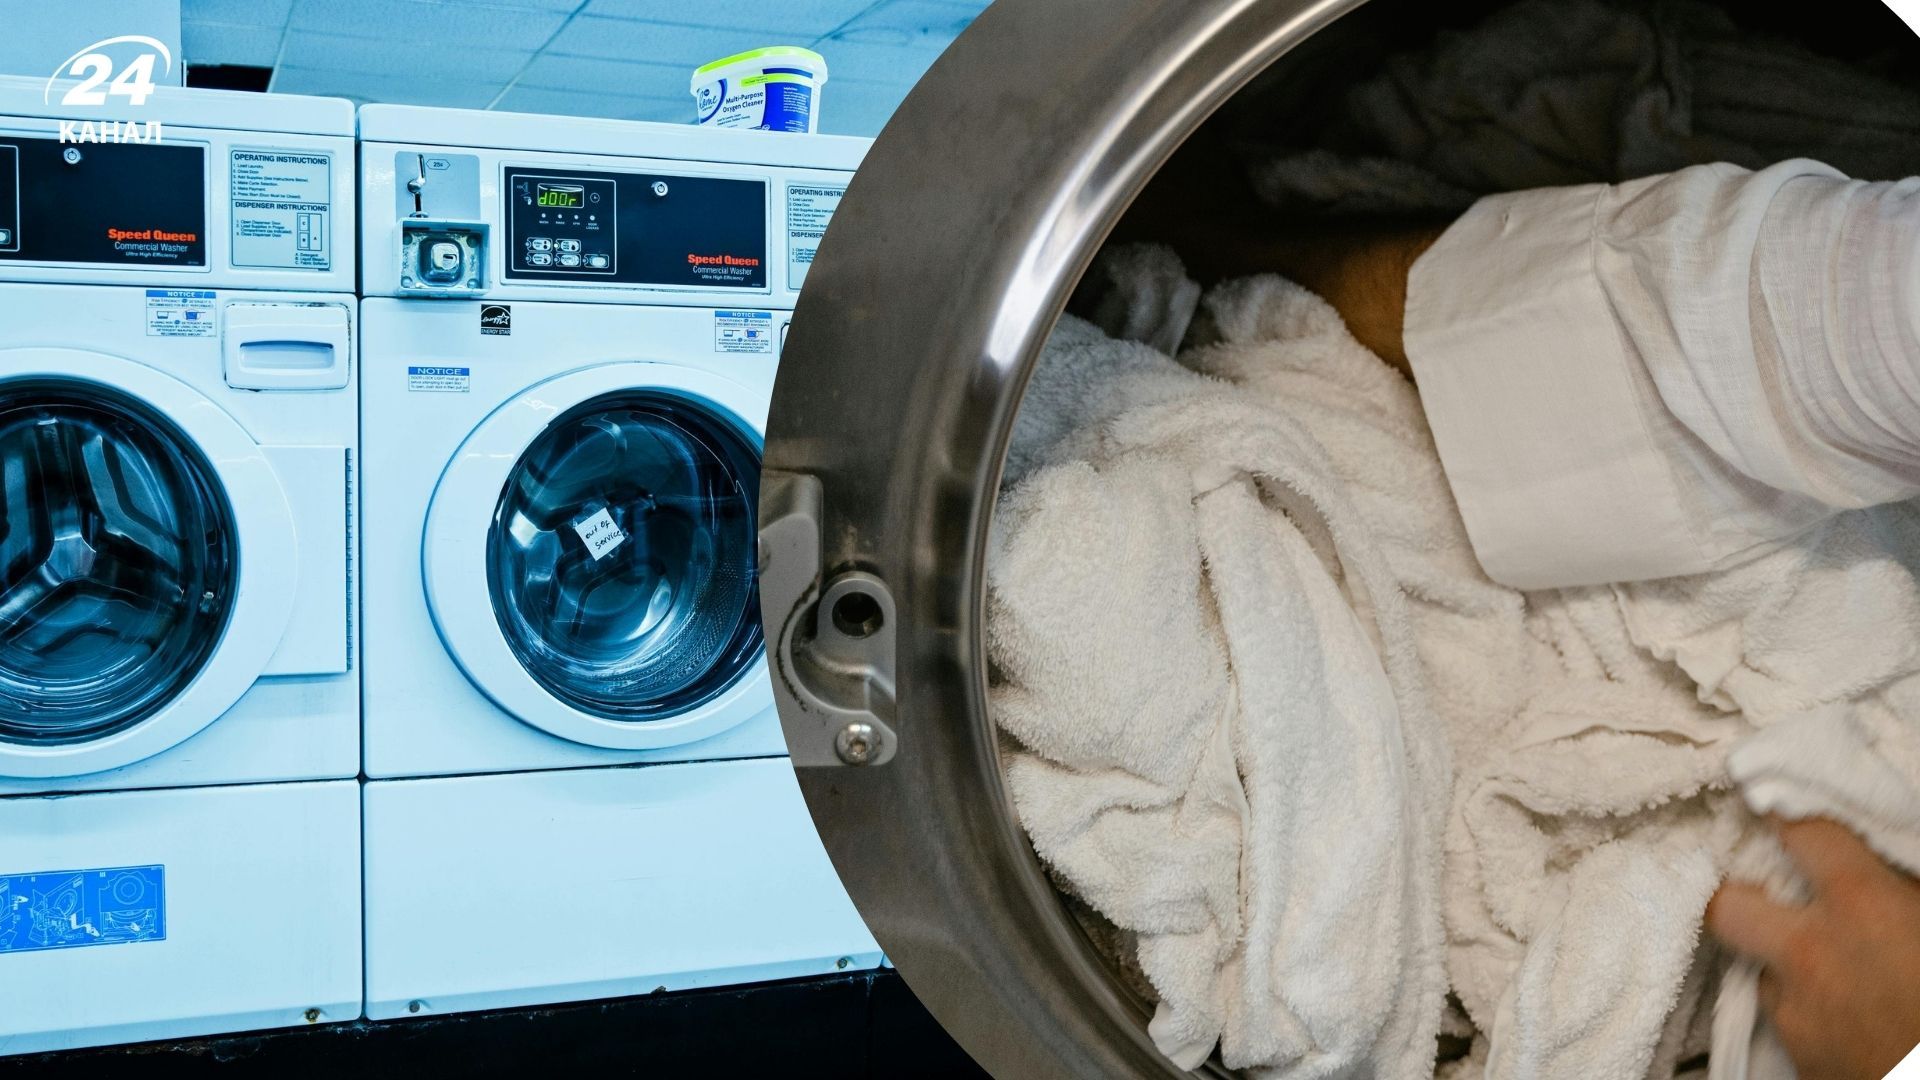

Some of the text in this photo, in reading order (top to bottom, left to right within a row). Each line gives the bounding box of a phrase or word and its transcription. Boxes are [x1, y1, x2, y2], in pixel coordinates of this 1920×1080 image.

[726, 92, 764, 104] Multi-Purpose
[723, 100, 764, 113] Oxygen Cleaner
[235, 154, 328, 165] OPERATING INSTRUCTIONS
[276, 204, 328, 212] INSTRUCTIONS
[108, 229, 196, 242] Speed Queen
[115, 242, 188, 252] Commercial Washer
[688, 254, 759, 266] Speed Queen
[693, 266, 752, 275] Commercial Washer
[586, 525, 598, 539] out
